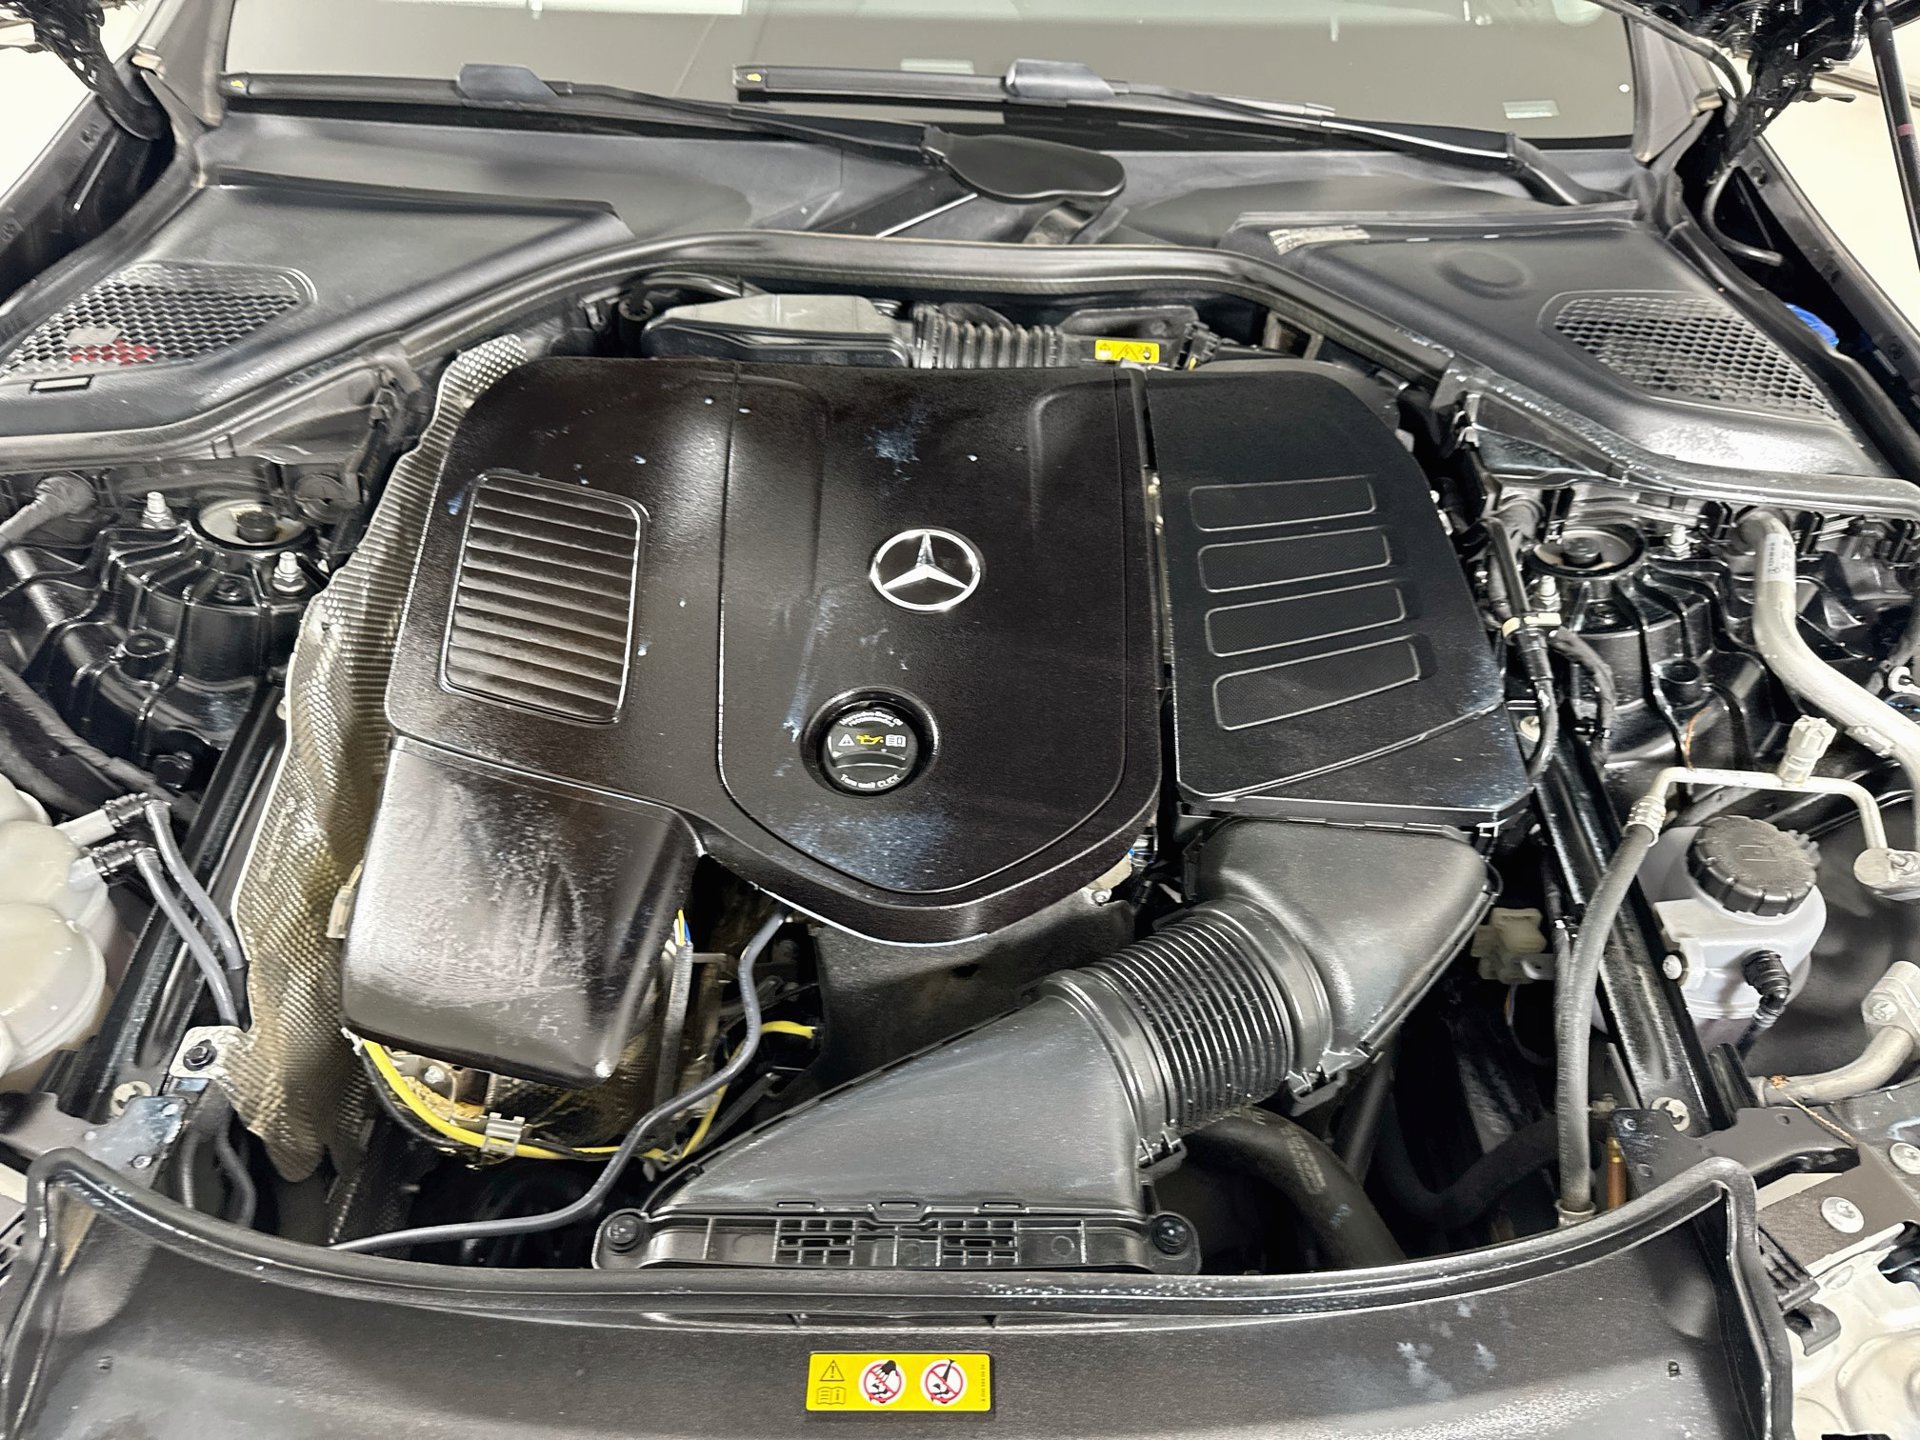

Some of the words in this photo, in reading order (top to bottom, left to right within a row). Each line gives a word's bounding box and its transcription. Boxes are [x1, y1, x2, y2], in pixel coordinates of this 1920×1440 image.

[840, 773, 857, 787] Turn
[858, 781, 876, 789] until
[876, 774, 901, 788] CLICK
